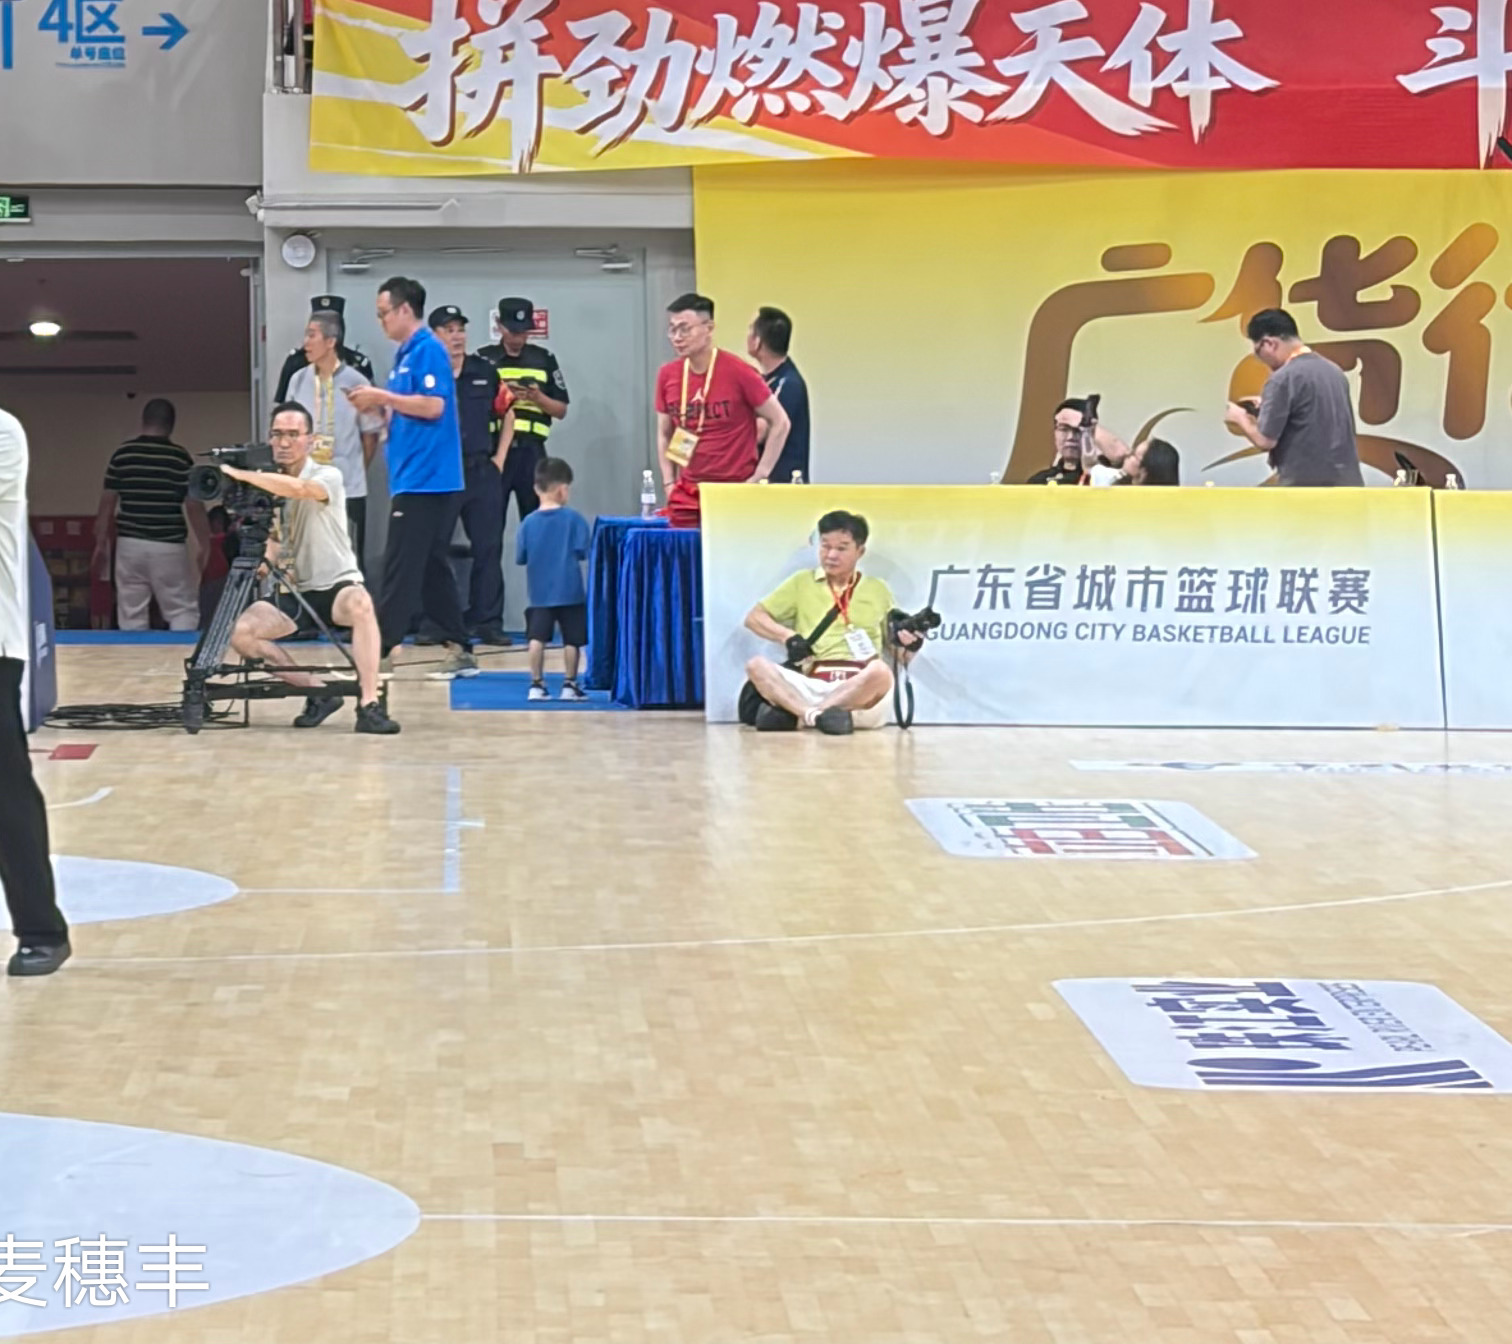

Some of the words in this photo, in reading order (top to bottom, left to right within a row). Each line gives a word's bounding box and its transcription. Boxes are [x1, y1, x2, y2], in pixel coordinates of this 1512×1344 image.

[928, 564, 1372, 616] 广东省城市篮球联赛
[926, 621, 1068, 642] GUANGDONG
[1075, 621, 1127, 643] CITY
[1132, 624, 1276, 644] BASKETBALL
[1283, 625, 1372, 645] LEAGUE
